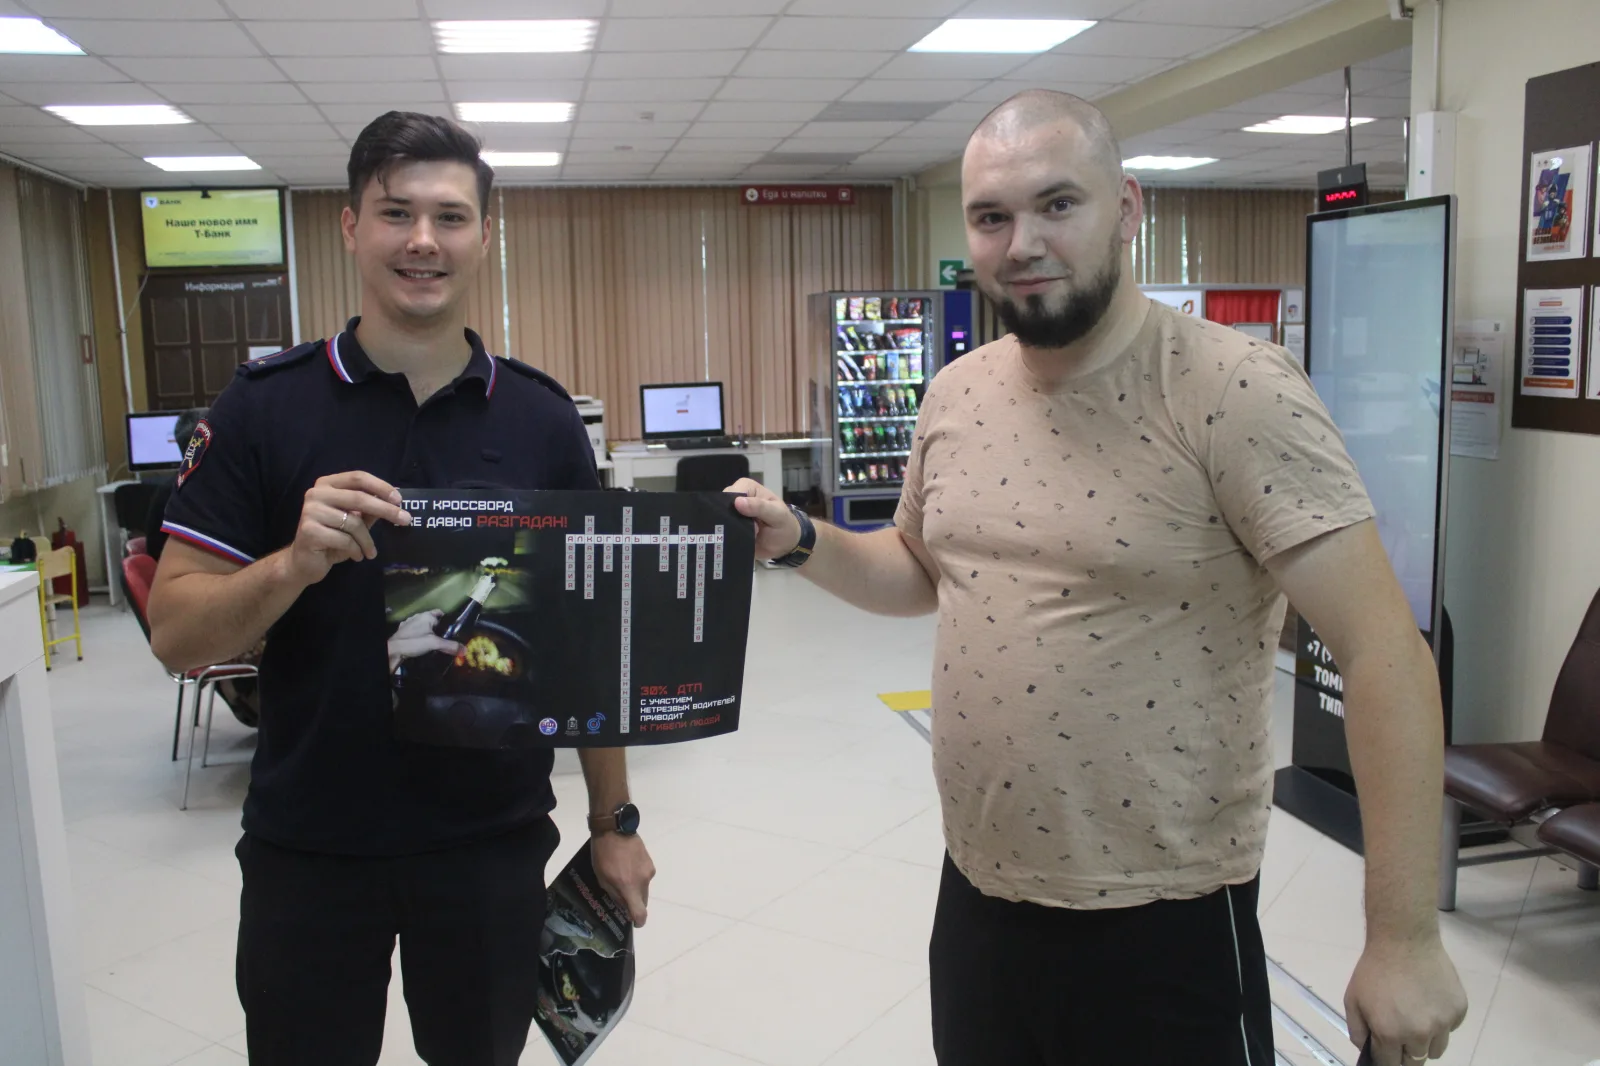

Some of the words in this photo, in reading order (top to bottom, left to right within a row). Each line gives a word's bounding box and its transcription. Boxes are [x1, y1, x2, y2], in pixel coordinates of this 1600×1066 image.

[763, 189, 778, 199] Еда
[166, 219, 196, 227] Наше
[195, 229, 231, 238] Т-Банк
[185, 282, 244, 292] Информация
[400, 500, 428, 510] ТОТ
[433, 500, 513, 512] КРОССВОРД
[427, 516, 471, 528] ДАВНО
[477, 515, 568, 529] РАЗГАДАН!
[567, 535, 641, 543] АЛКОГОЛЬ
[652, 535, 669, 543] ЗА
[660, 517, 669, 570] ТРАВМЫ
[566, 535, 574, 589] АВАРИЯ
[585, 517, 594, 598] НАКАЗАНИЕ
[678, 527, 687, 597] ТРАГЕДИЯ
[1307, 640, 1320, 657] +7
[640, 685, 668, 695] 30%
[677, 683, 703, 695] ДТП
[640, 704, 690, 713] НЕТРЕЗВЫХ
[693, 695, 736, 709] ВОДИТЕЛЕЙ
[649, 696, 693, 705] УЧАСТИЕМ
[640, 713, 684, 721] ПРИВОДИТ
[650, 721, 687, 731] ГИБЕЛИ
[690, 714, 721, 727] ЛЮДЕЙ
